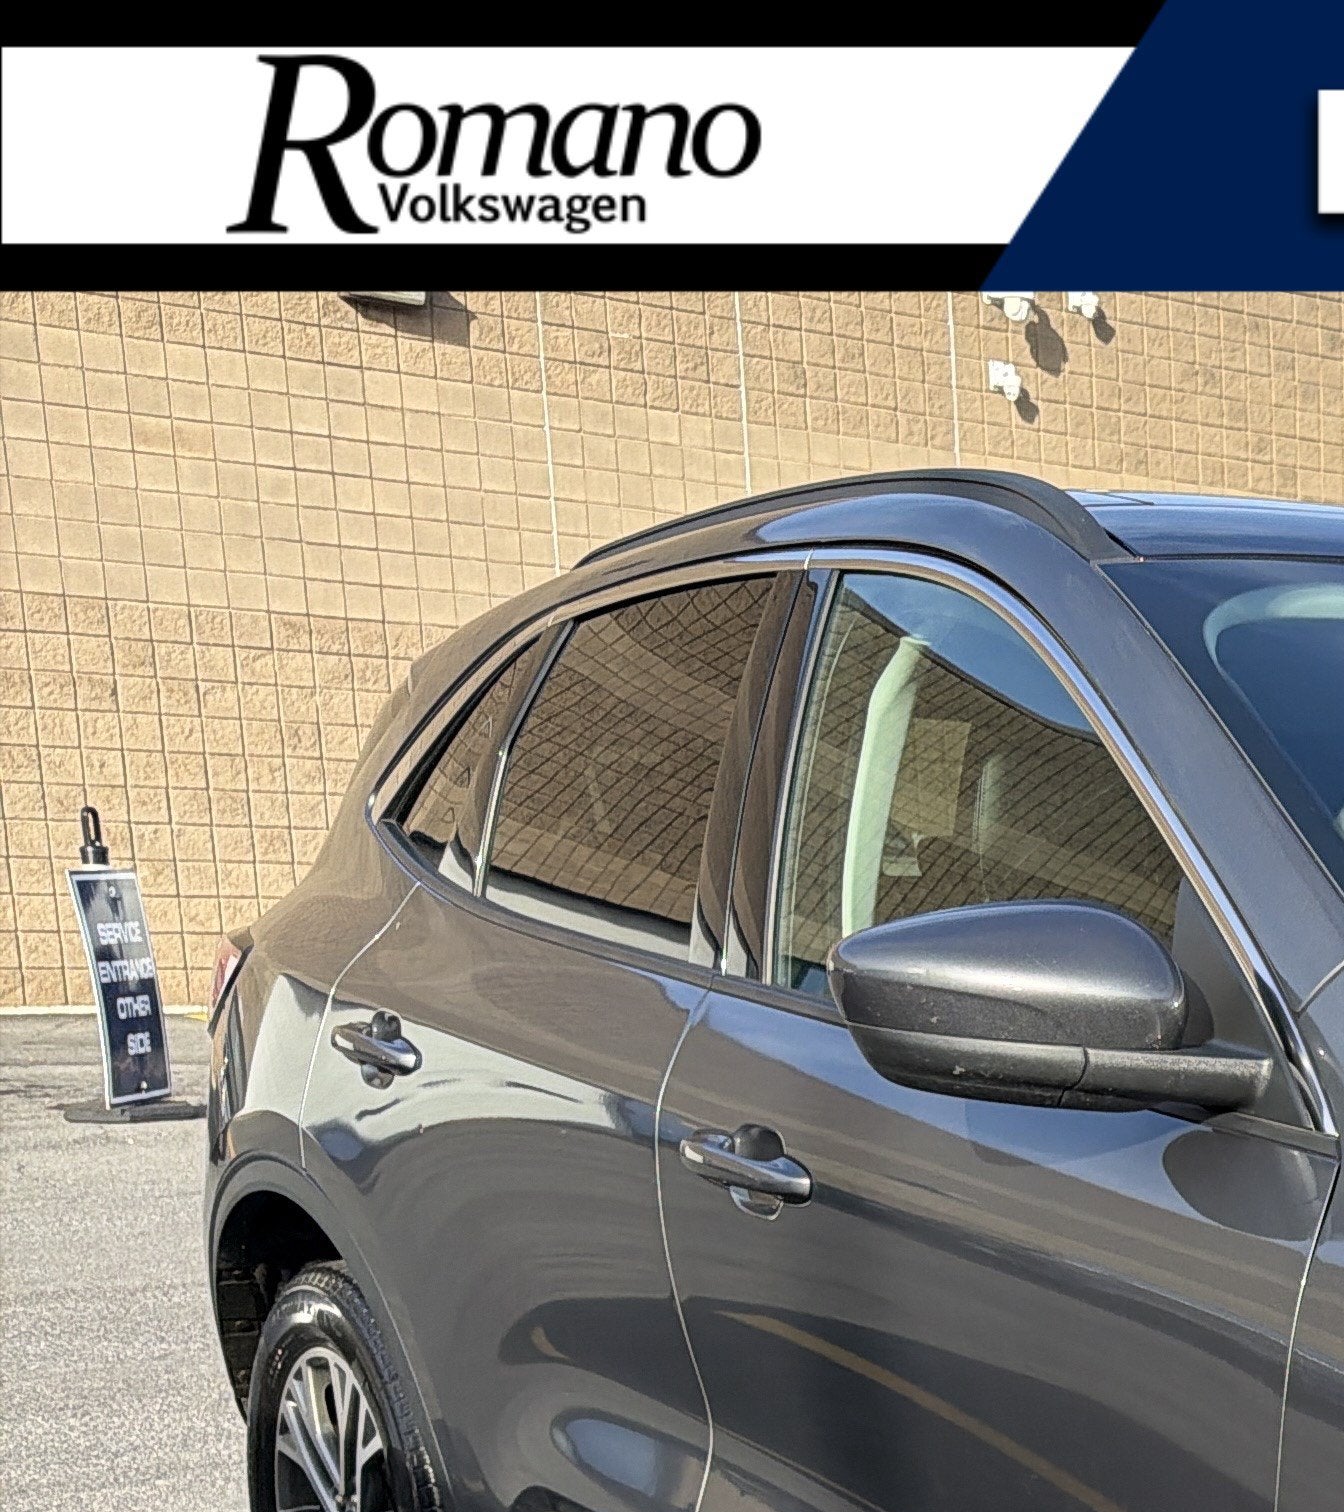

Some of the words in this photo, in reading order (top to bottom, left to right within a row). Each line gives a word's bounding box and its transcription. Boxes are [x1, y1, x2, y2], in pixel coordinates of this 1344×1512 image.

[96, 921, 143, 945] SERVICE
[97, 957, 155, 983] ENTRANCE
[116, 995, 152, 1019] OTHER
[126, 1032, 152, 1056] SIDE
